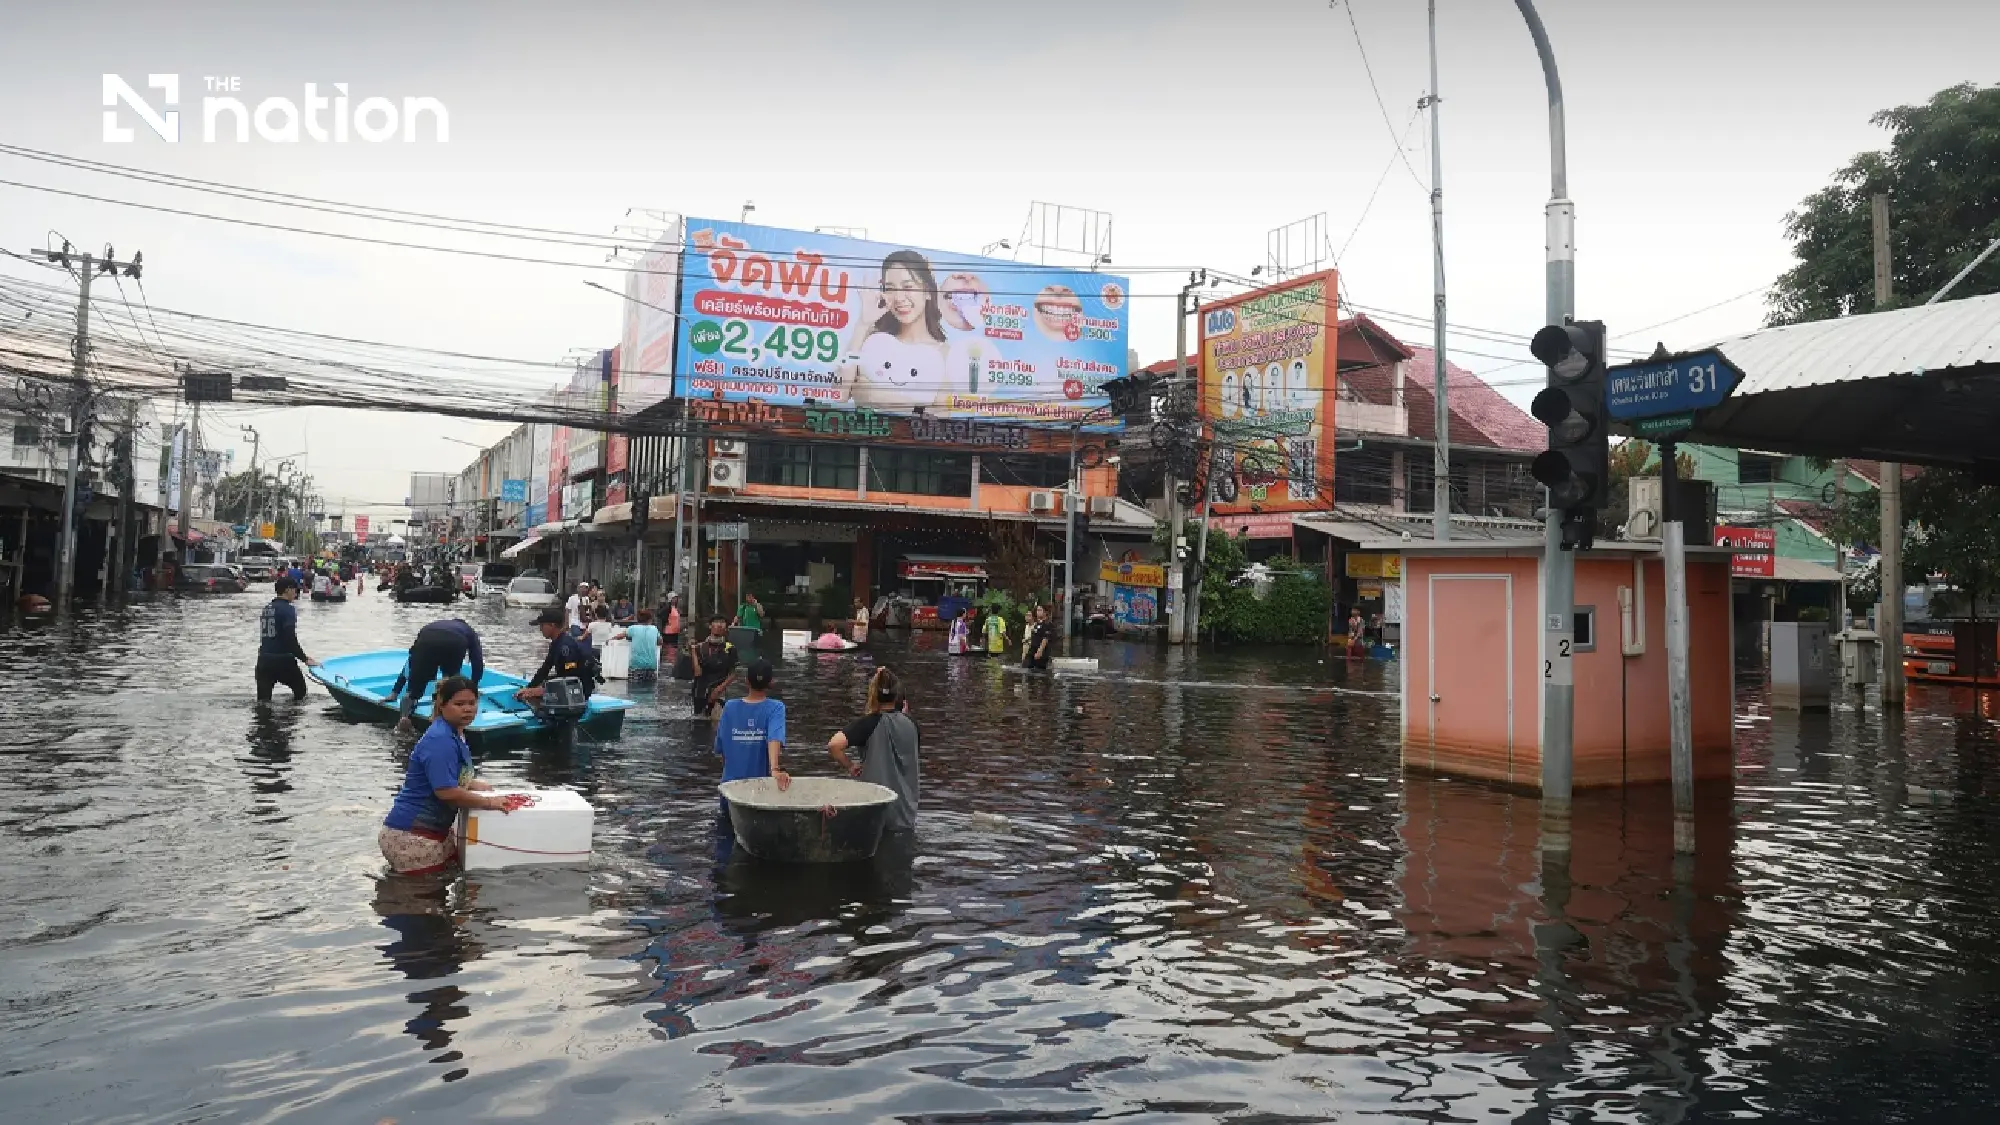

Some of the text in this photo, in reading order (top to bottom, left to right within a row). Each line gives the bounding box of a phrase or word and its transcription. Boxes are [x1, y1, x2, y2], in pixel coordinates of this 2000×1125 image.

[710, 236, 849, 304] จัดฟัน
[1688, 363, 1717, 393] 31
[1559, 639, 1570, 657] 2
